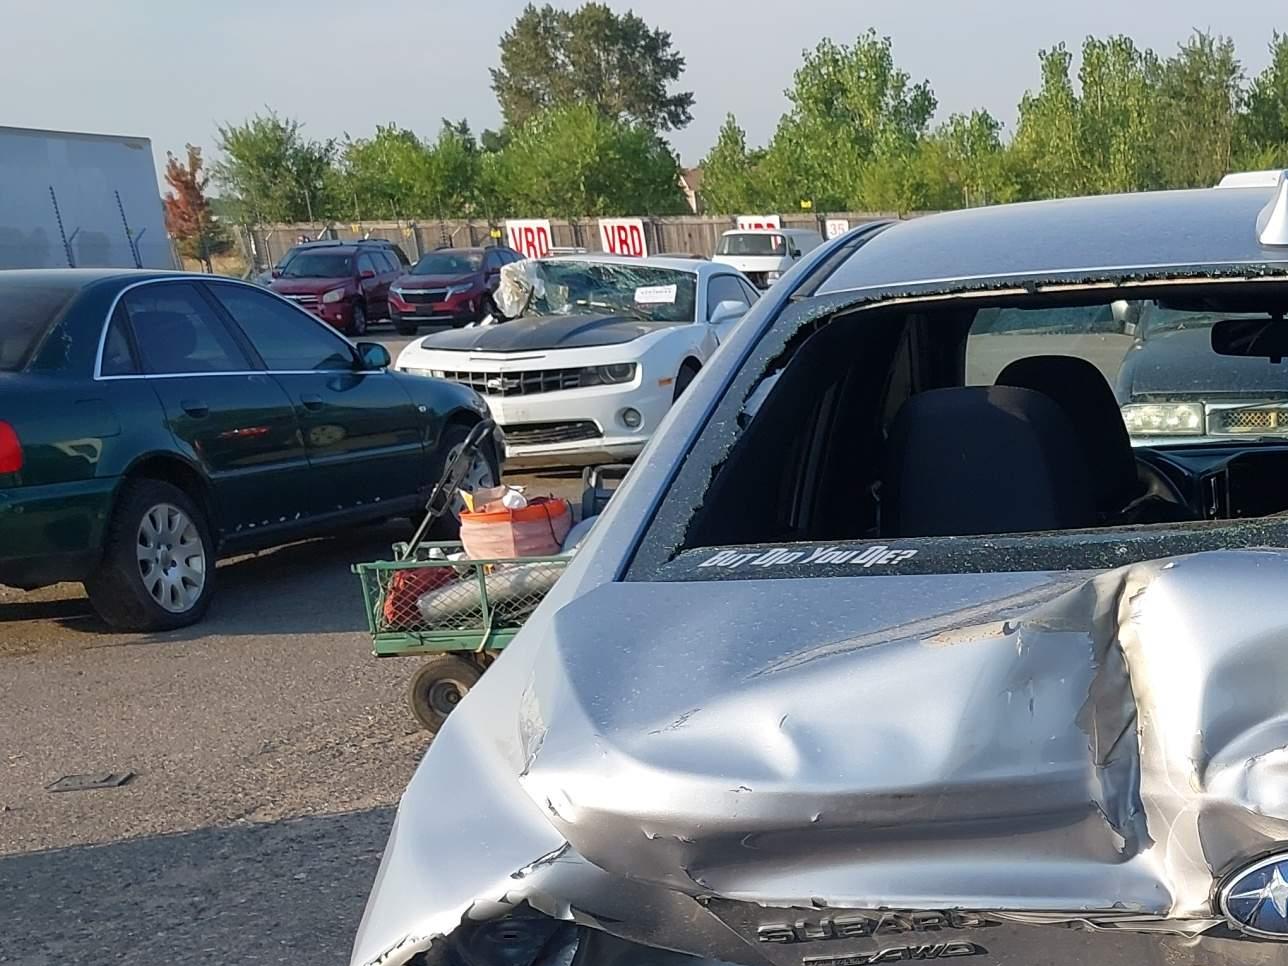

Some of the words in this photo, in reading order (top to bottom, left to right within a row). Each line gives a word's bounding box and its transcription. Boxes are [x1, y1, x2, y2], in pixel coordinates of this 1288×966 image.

[511, 226, 550, 259] VRD
[604, 225, 643, 257] VRD
[868, 940, 988, 964] AWD
